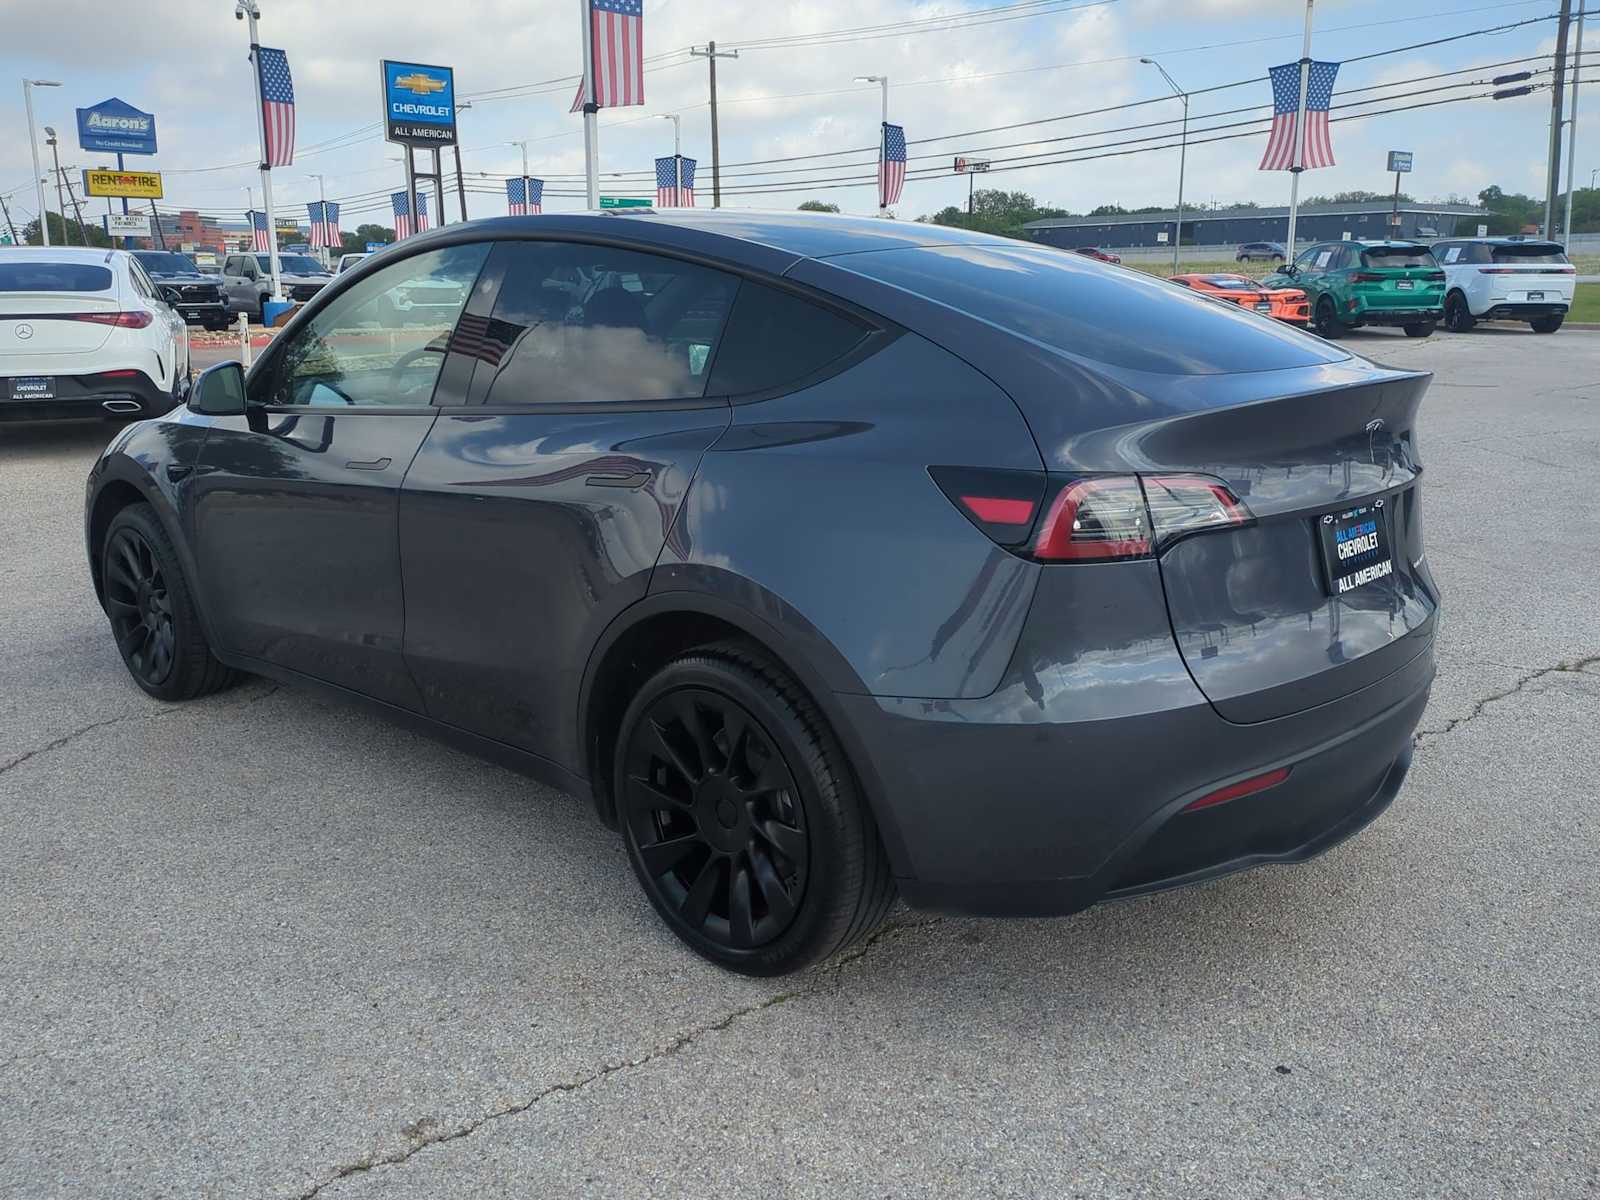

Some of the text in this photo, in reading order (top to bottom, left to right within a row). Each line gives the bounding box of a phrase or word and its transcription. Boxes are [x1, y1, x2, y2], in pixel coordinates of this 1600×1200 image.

[393, 103, 450, 116] CHEVROLET
[87, 112, 149, 129] Aaron's
[395, 127, 453, 139] ALL AMERICAN
[1336, 520, 1377, 544] ALL AMERICAN
[1337, 532, 1379, 560] CHEVROLET
[1339, 575, 1355, 593] ALL
[1355, 560, 1393, 587] AMERICAN
